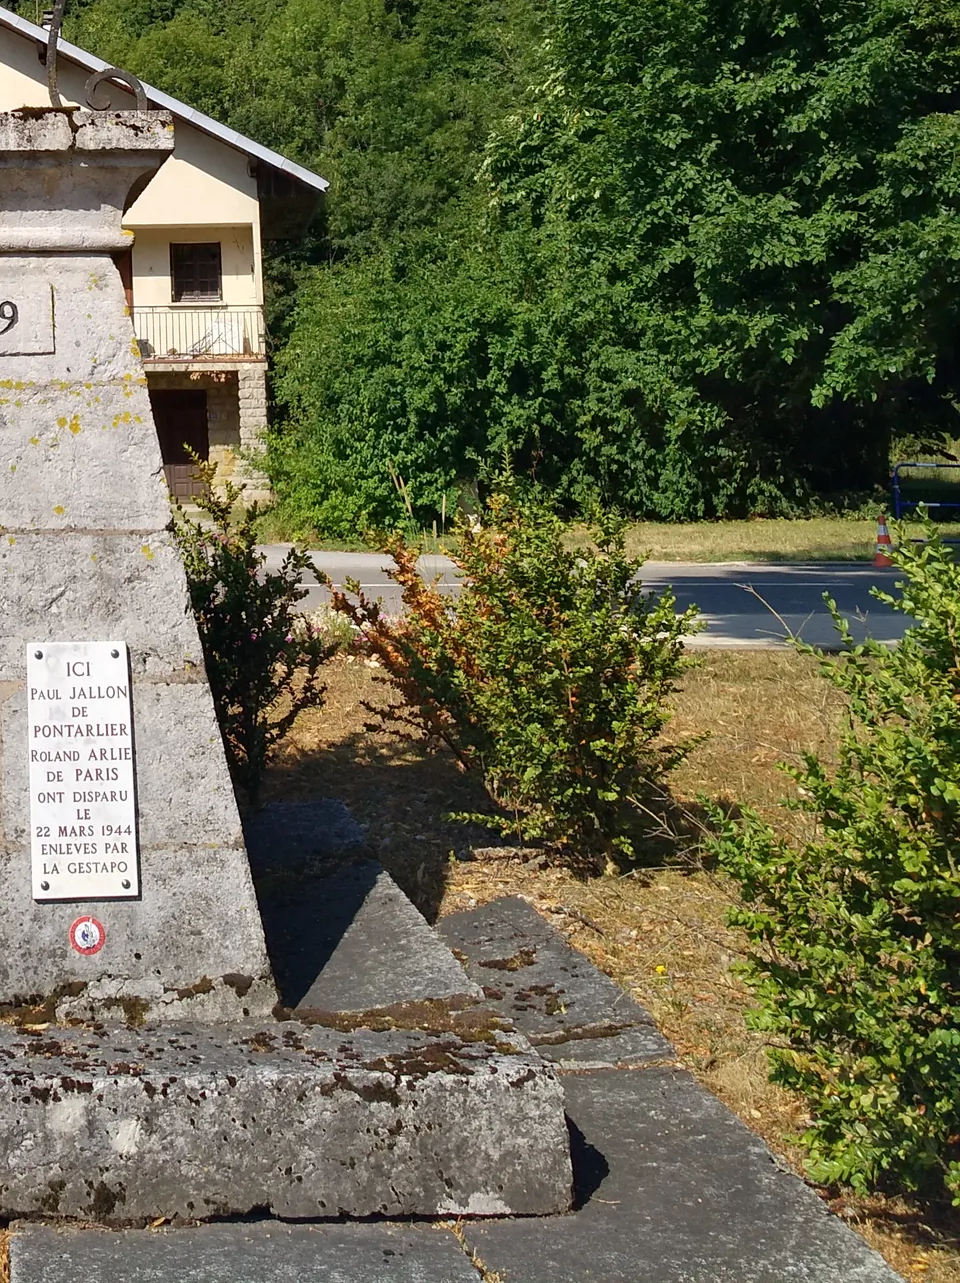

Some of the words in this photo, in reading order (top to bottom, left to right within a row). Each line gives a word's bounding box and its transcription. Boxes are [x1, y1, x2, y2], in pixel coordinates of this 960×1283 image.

[66, 661, 91, 677] ICI
[69, 685, 128, 700] JALLON
[71, 706, 88, 718] DE
[33, 723, 129, 738] PONTARLIER
[88, 747, 132, 761] ARLIE
[46, 771, 64, 782] DE
[75, 767, 119, 782] PARIS
[37, 791, 65, 804] ONT
[73, 790, 128, 803] DISPARU
[76, 808, 91, 820] LE
[36, 826, 51, 837] 22
[58, 825, 94, 837] MARS
[101, 824, 132, 836] 1944
[41, 842, 97, 855] ENLEVES
[104, 842, 129, 854] PAR
[43, 862, 60, 874] LA
[67, 861, 128, 874] GESTAPO
